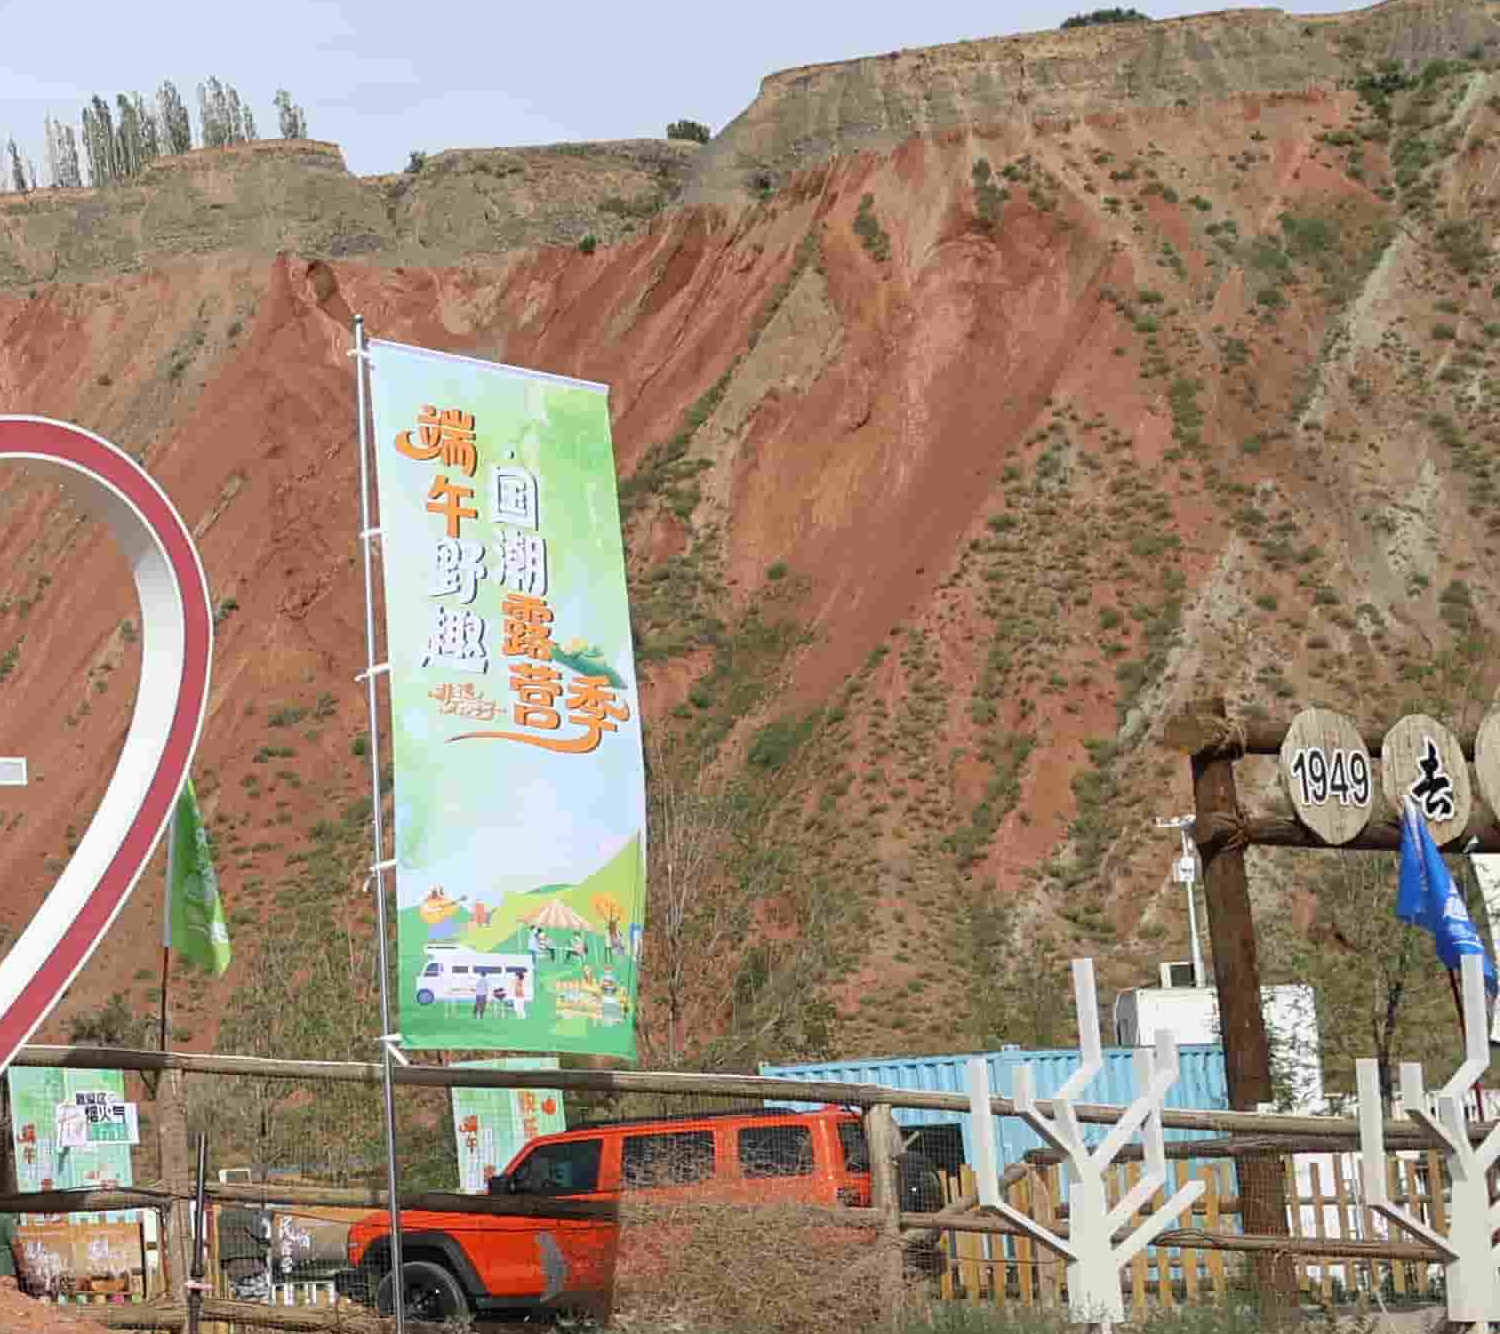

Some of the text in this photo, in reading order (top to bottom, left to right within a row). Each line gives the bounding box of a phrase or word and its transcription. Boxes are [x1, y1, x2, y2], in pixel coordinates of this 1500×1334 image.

[393, 404, 488, 674] 端午野趣
[1293, 746, 1371, 805] 1949
